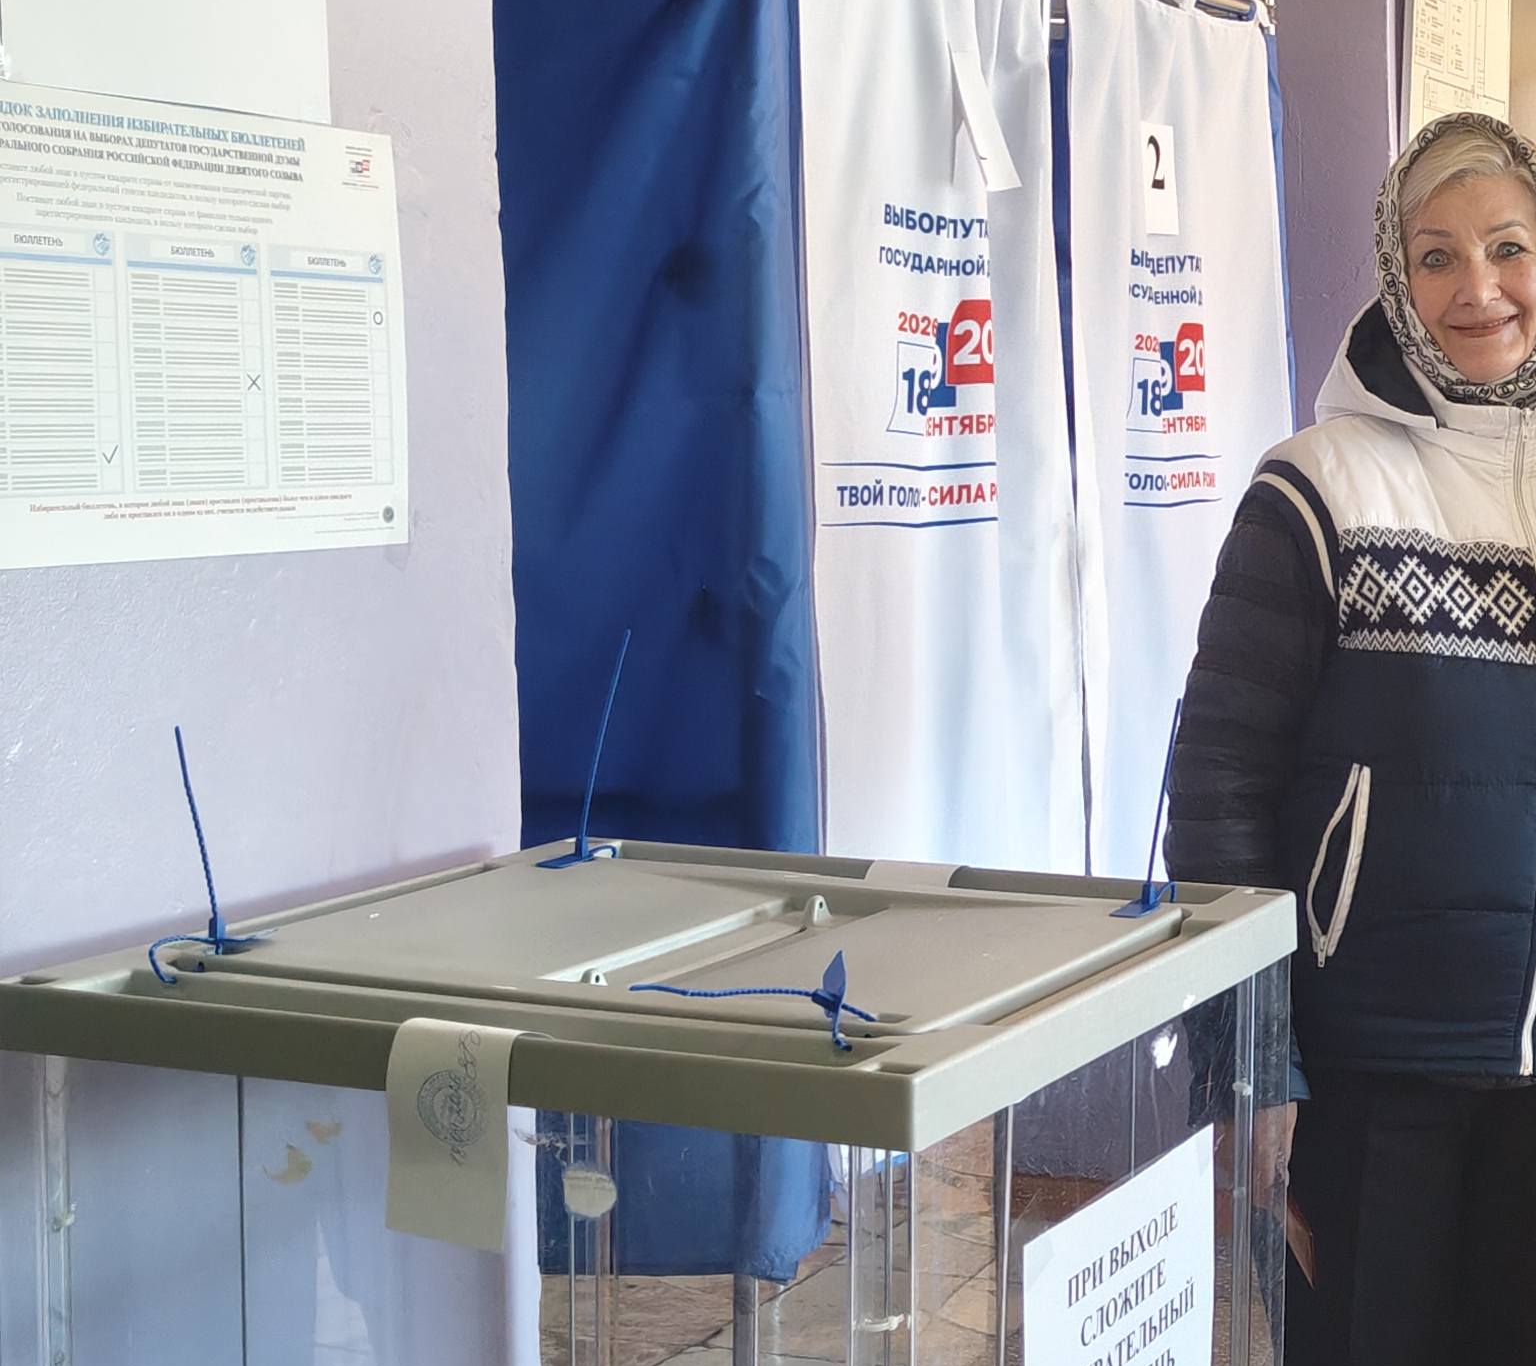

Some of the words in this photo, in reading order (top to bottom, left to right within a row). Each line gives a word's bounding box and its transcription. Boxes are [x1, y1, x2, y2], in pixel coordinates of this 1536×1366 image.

[36, 105, 125, 129] ЗАПОЛНЕНИЯ
[127, 117, 230, 143] ИЗБИРАТЕЛЬНЫХ
[231, 131, 306, 153] БЮЛЛЕТЕНЕЙ
[52, 144, 105, 160] СОБРАНИЯ
[106, 150, 171, 168] РОССИЙСКОЙ
[171, 158, 225, 174] ФЕДЕРАЦИИ
[73, 129, 88, 142] НА
[89, 131, 135, 147] ВЫБОРАХ
[135, 137, 188, 155] ДЕПУТАТОВ
[189, 144, 274, 164] ГОСУДАРСТВЕННОЙ
[274, 154, 300, 167] ДУМЫ
[1146, 134, 1166, 191] 2
[14, 233, 64, 247] БЮЛЛЕТЕНЬ
[170, 245, 215, 259] БЮЛЛЕТЕНЬ
[307, 256, 347, 268] БЮЛЛЕТЕНЬ
[1134, 333, 1160, 354] 202
[902, 367, 931, 416] 18
[1137, 378, 1162, 418] 18
[837, 479, 884, 508] ТВОЙ
[928, 483, 987, 507] СИЛА
[1170, 471, 1201, 490] СИЛА
[1067, 1254, 1105, 1310] ПРИ
[1109, 1201, 1179, 1279] ВЫХОДЕ
[1080, 1257, 1167, 1348] СЛОЖИТЕ
